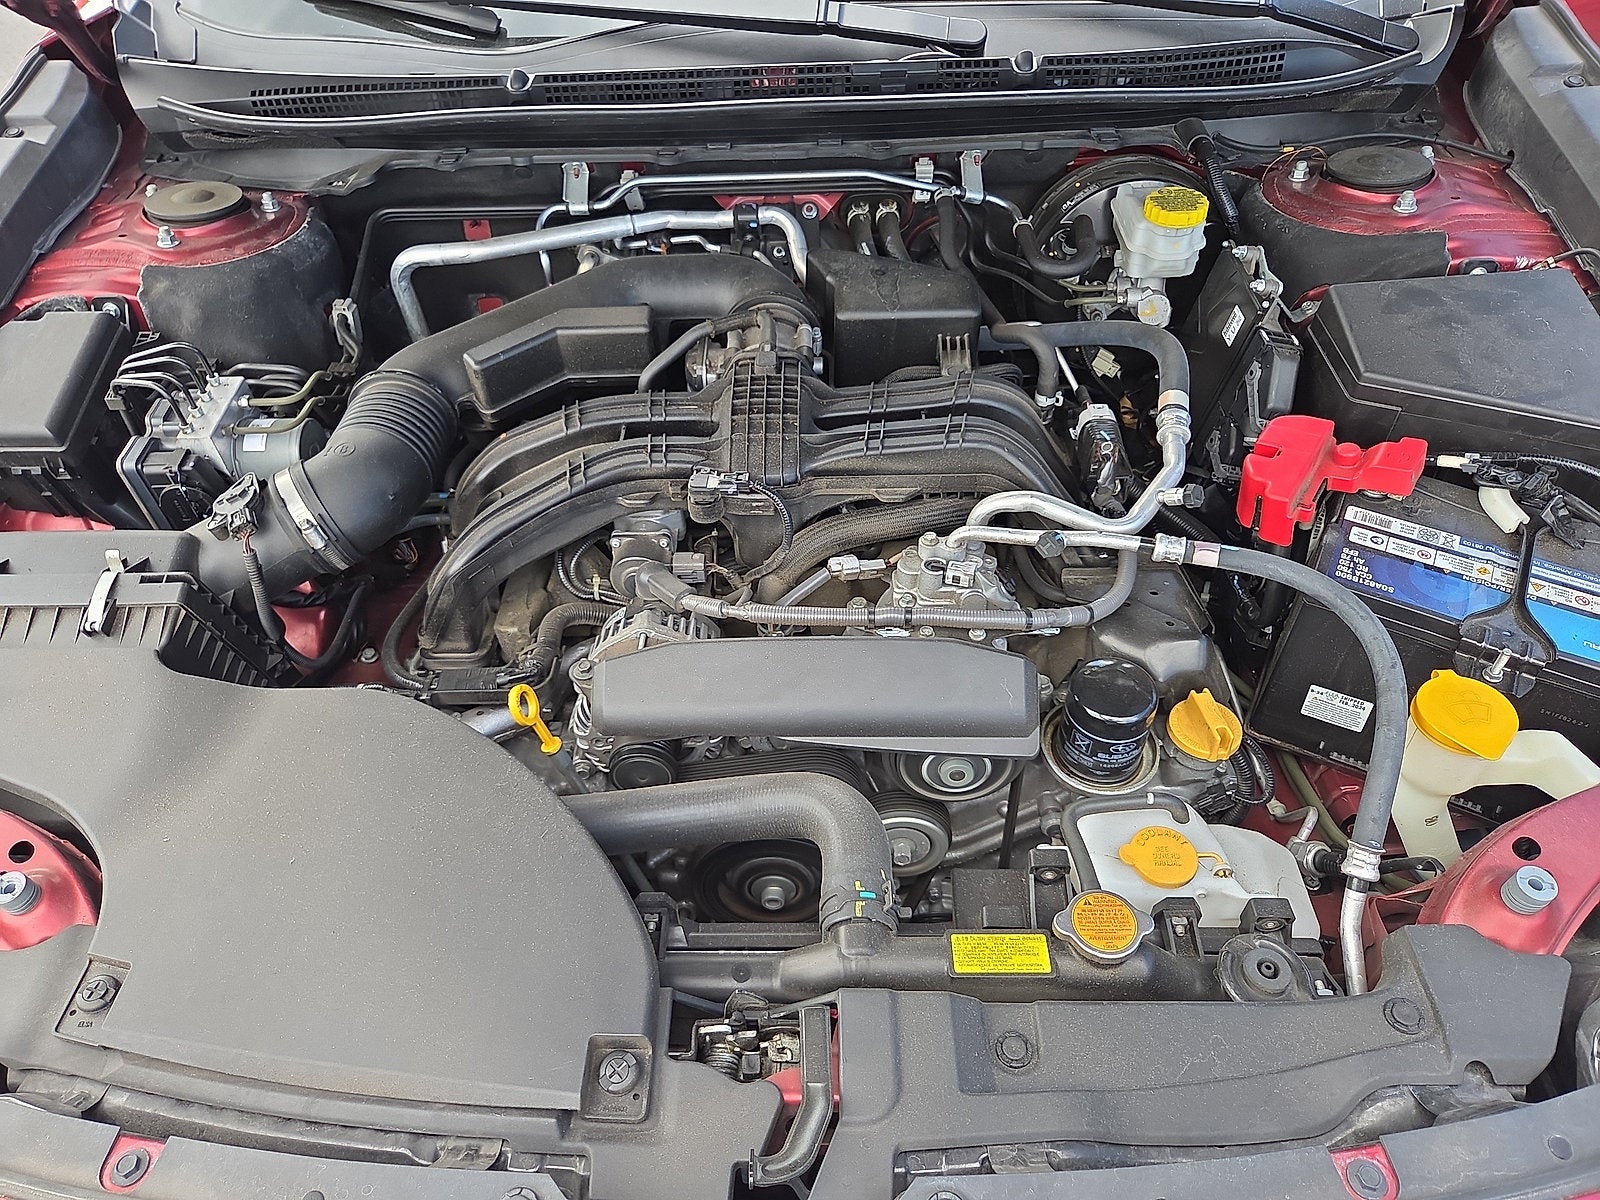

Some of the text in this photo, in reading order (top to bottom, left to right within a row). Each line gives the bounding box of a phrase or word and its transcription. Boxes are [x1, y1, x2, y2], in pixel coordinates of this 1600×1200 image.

[1353, 556, 1366, 565] Ah
[1356, 563, 1369, 572] RC
[1354, 569, 1373, 580] CCA
[1136, 828, 1189, 846] COOLANT
